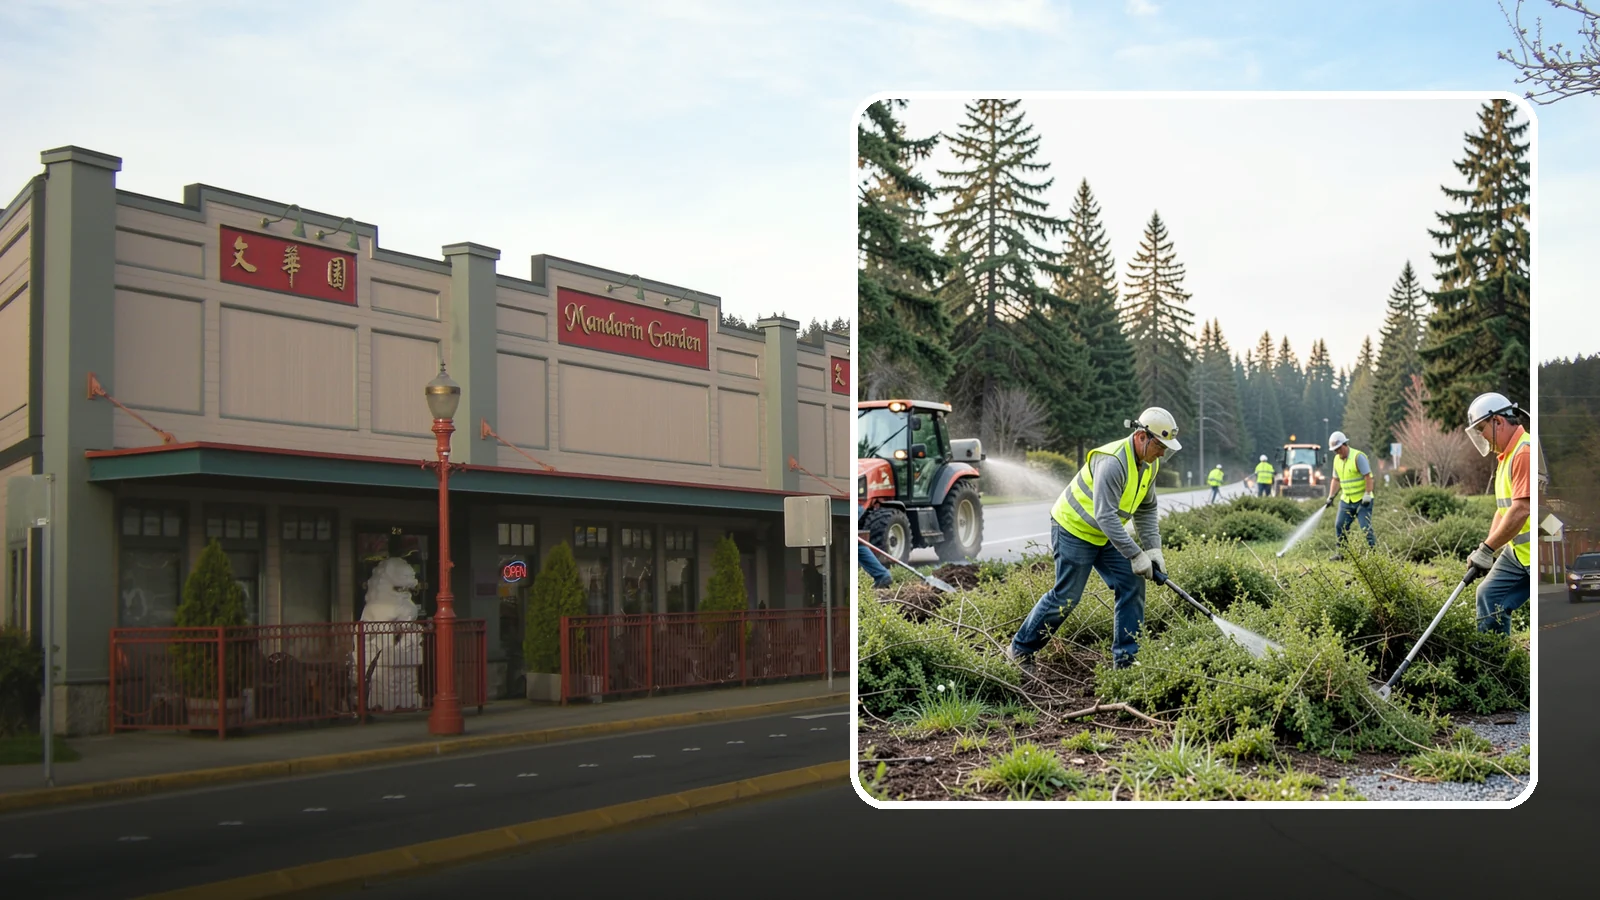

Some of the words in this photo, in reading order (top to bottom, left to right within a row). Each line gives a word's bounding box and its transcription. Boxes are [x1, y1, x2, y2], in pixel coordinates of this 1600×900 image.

[231, 236, 346, 290] 文華園
[564, 302, 643, 341] Mandarin
[648, 320, 701, 352] Garden
[503, 565, 527, 578] OPEN
